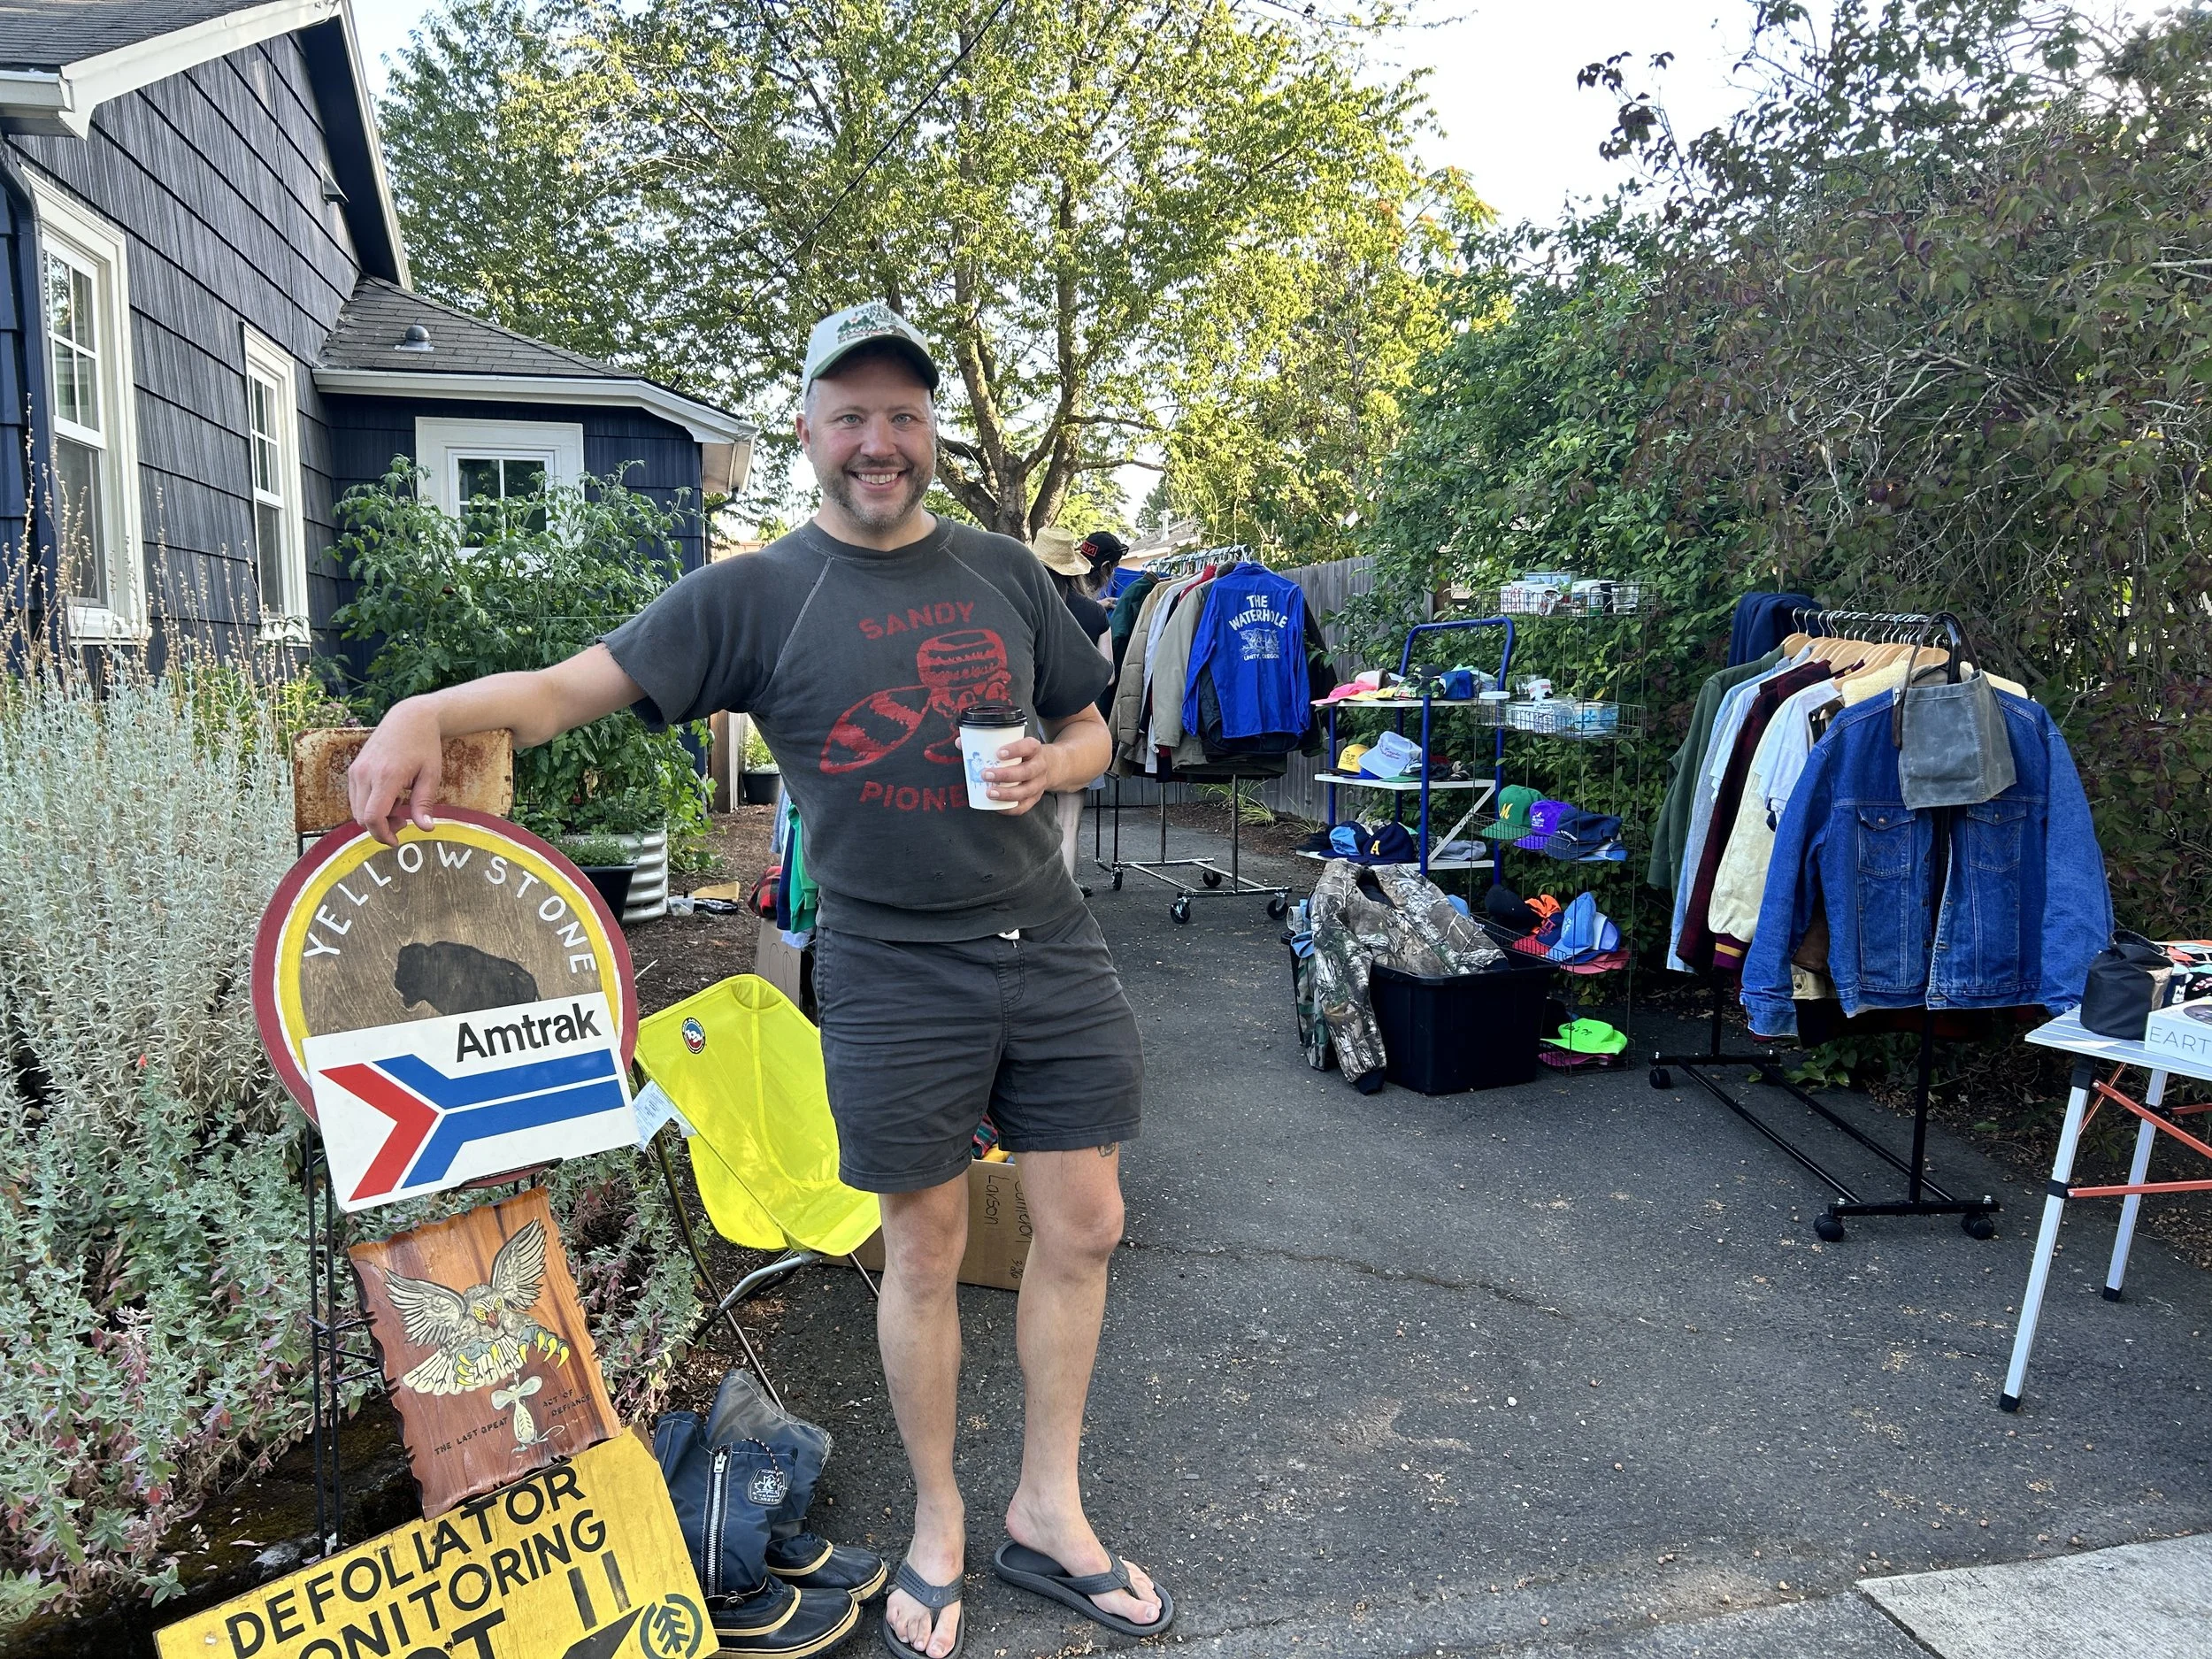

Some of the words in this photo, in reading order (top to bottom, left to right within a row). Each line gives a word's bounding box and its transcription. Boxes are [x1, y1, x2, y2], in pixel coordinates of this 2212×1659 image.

[1246, 594, 1268, 608] THE
[858, 601, 974, 641] SANDY
[1228, 608, 1288, 631] WATERHOLE
[858, 780, 969, 812] PIONE
[1370, 840, 1380, 856] A
[303, 841, 597, 974] YELLOWSTONE
[456, 1002, 603, 1064] Amtrak
[2149, 1025, 2212, 1056] EART
[542, 1394, 558, 1409] ACT
[563, 1388, 574, 1400] OF
[550, 1393, 593, 1417] DEFIANCE
[434, 1441, 452, 1455] THE
[457, 1429, 479, 1445] LAST
[225, 1465, 587, 1659] DEFOLIATOR
[298, 1509, 607, 1659] NITORING
